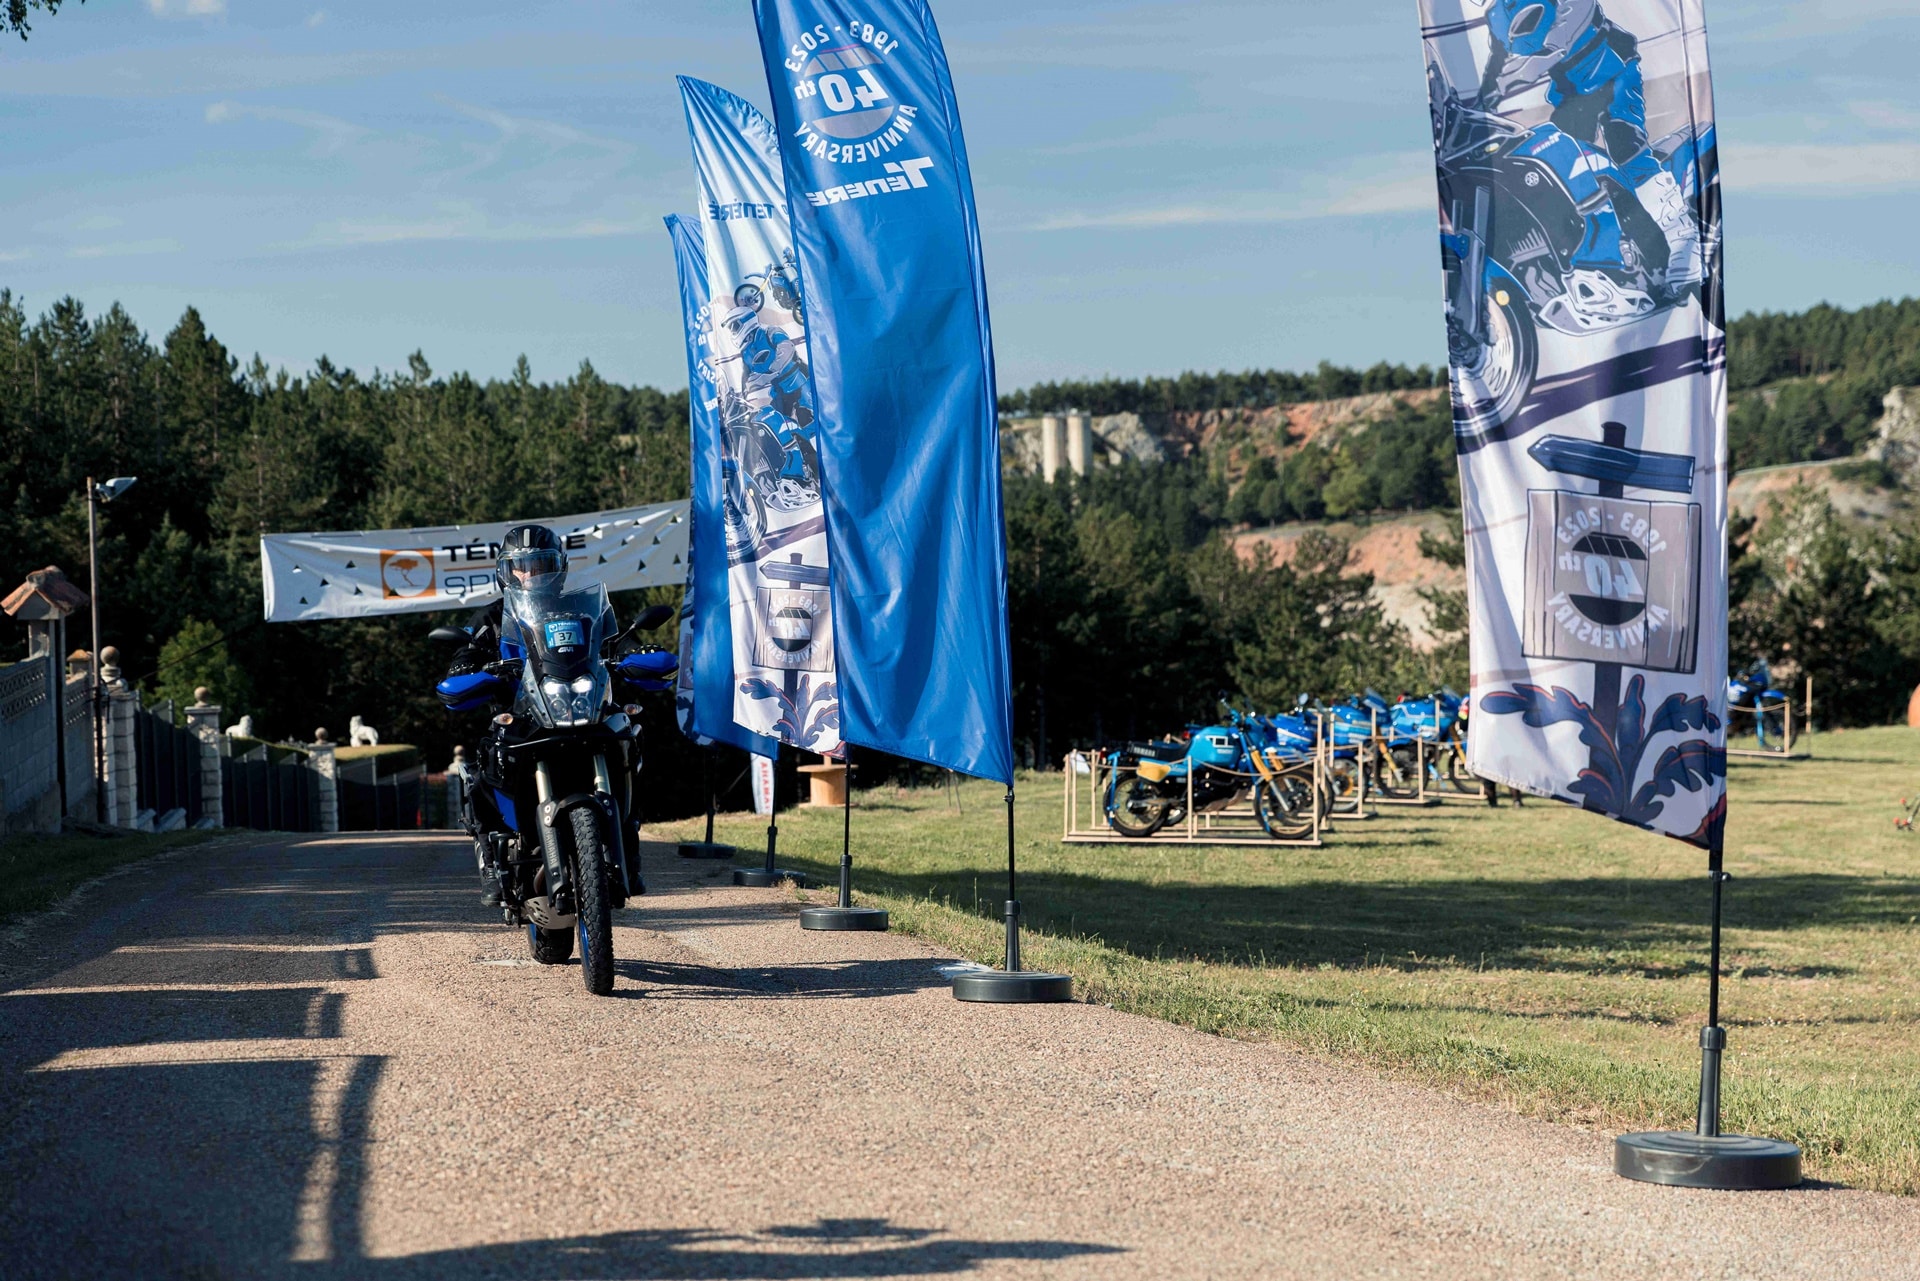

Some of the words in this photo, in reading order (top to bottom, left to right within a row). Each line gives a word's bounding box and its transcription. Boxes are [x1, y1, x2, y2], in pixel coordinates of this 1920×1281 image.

[442, 528, 586, 562] TÉNÉ
[444, 574, 496, 595] SPI
[558, 632, 573, 642] 37
